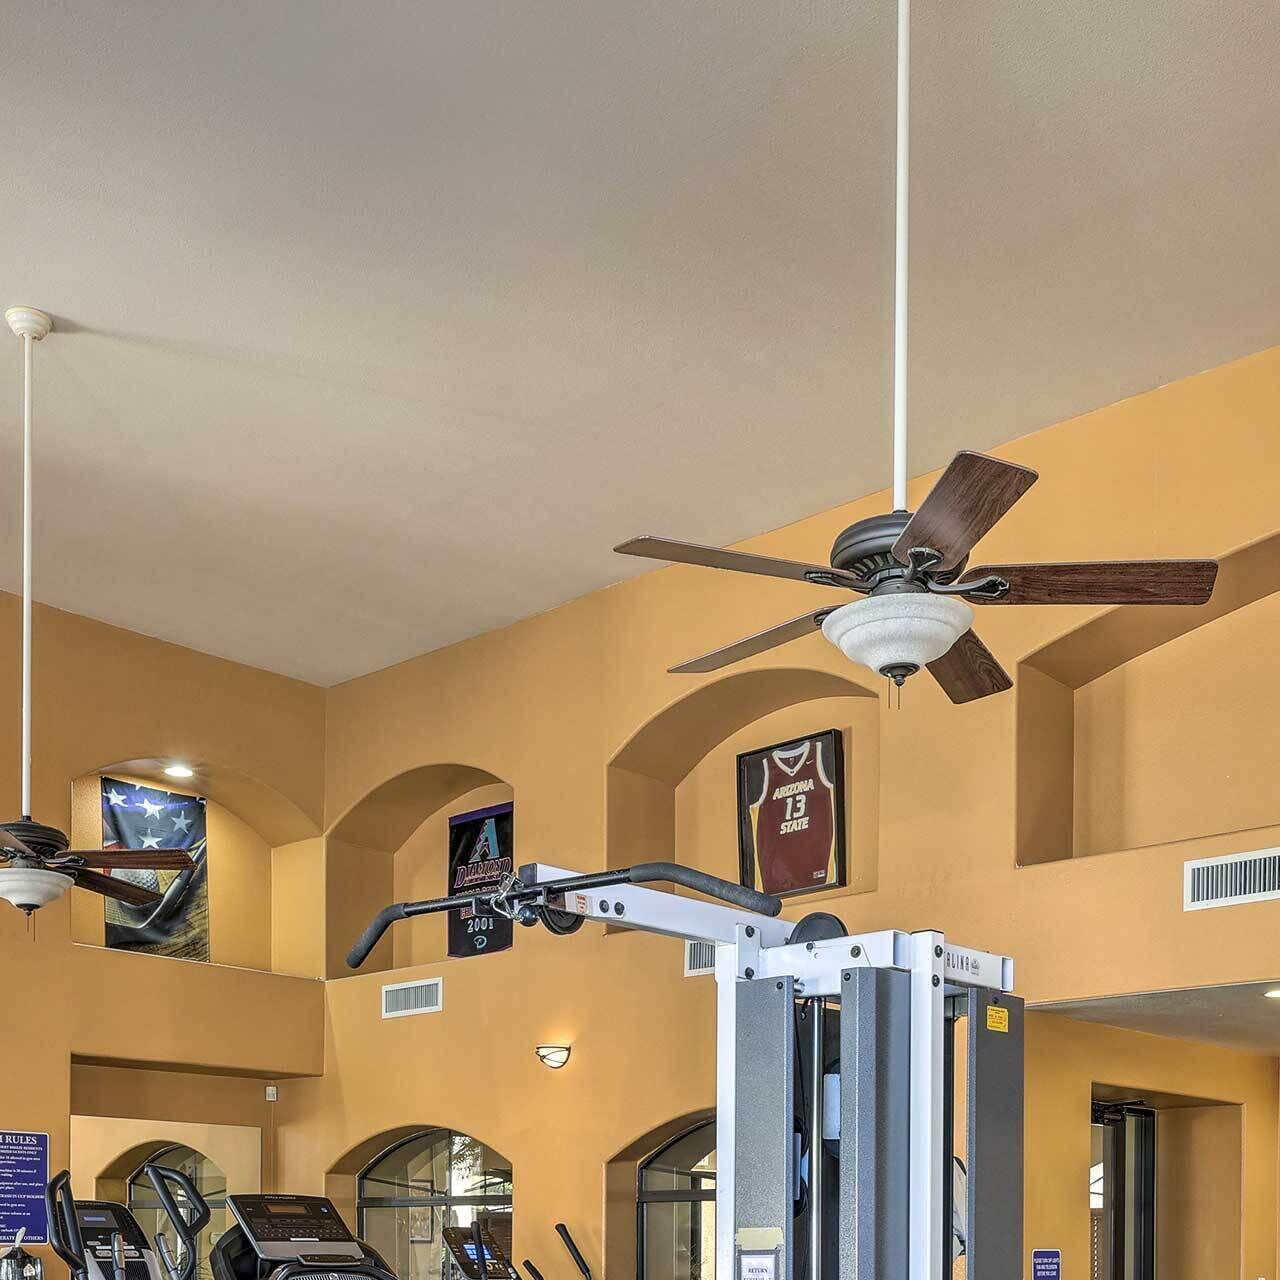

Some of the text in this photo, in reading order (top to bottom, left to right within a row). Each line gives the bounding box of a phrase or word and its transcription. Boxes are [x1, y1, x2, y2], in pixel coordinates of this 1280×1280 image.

[772, 779, 815, 800] ARIZONA
[784, 794, 806, 820] 13
[780, 817, 809, 834] STATE
[467, 918, 494, 933] 2001
[5, 1135, 38, 1145] RULES
